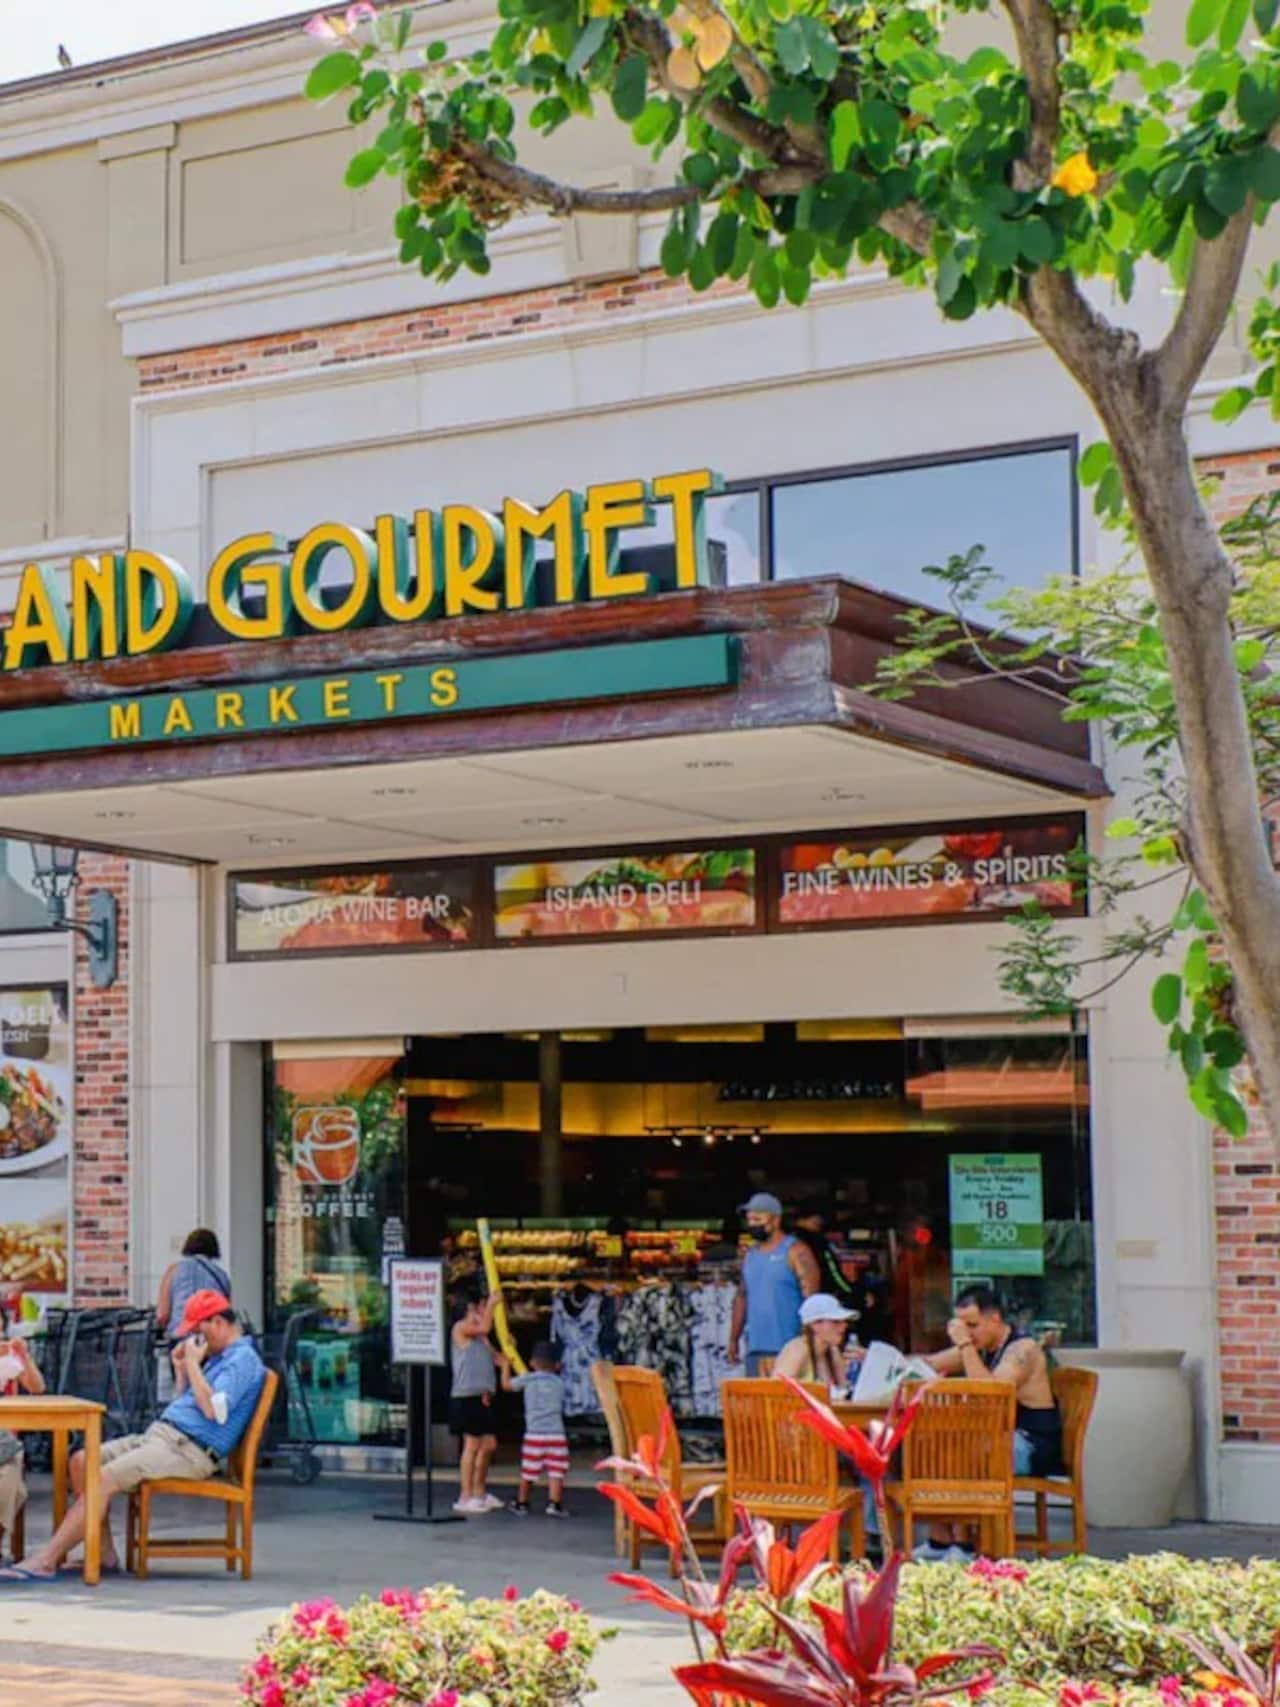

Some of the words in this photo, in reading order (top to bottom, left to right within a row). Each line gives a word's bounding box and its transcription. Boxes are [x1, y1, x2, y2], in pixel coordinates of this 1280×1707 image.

[206, 467, 716, 640] GOURMET
[109, 668, 459, 740] MARKETS
[544, 882, 637, 913] ISLAND
[645, 879, 701, 908] DELI
[782, 868, 840, 898] FINE
[848, 861, 934, 892] WINES
[943, 861, 967, 887] &
[973, 853, 1068, 886] SPIRITS
[342, 897, 399, 924] WINE
[405, 894, 451, 920] BAR
